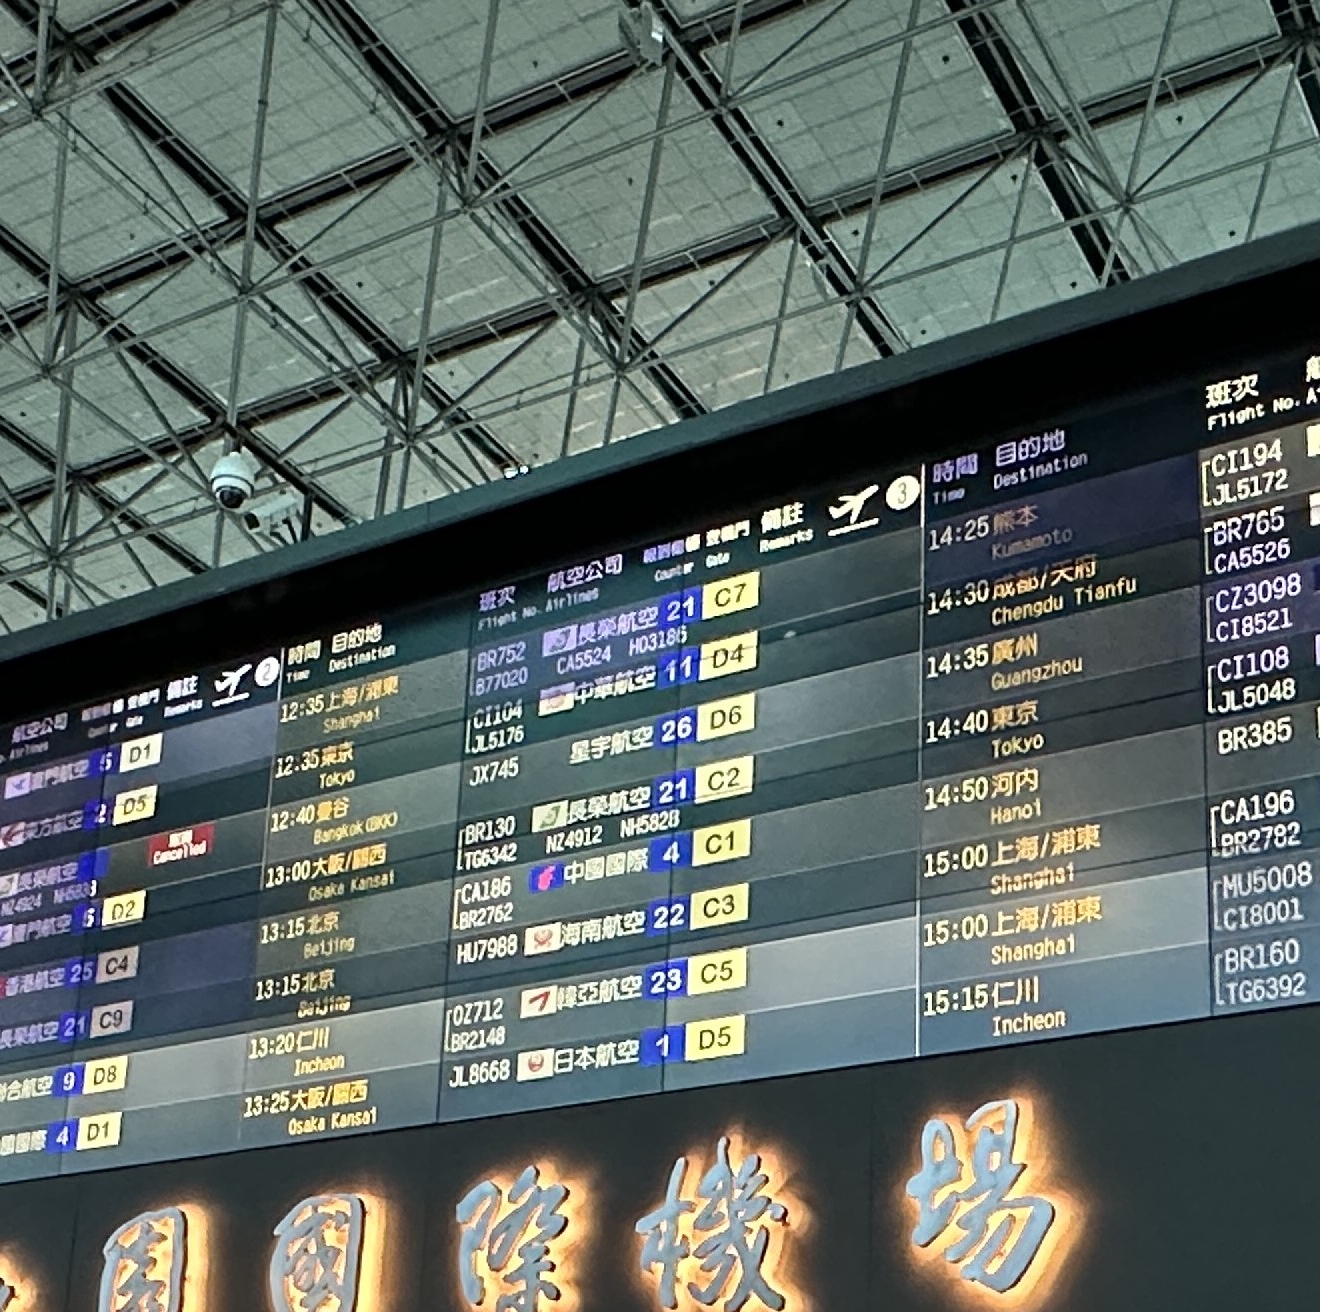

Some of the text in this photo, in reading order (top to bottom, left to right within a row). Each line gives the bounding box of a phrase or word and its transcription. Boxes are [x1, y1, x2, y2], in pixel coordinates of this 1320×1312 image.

[1205, 374, 1258, 407] 班次
[996, 429, 1065, 467] 目的地
[1212, 440, 1283, 477] CI194
[993, 450, 1088, 491] Destination
[1212, 471, 1288, 506] JL5172
[929, 515, 990, 551] 14:25
[991, 526, 1073, 560] Kumamoto
[1213, 507, 1285, 546] BR765
[1213, 538, 1291, 573] CA5526
[667, 583, 748, 621] 21 C7
[928, 579, 989, 616] 14:30
[991, 576, 1137, 626] Chengdu Tianfu
[1215, 573, 1302, 612] CZ3098
[1215, 607, 1293, 643] CI8521
[477, 642, 527, 672] BR752
[664, 644, 744, 681] 11 D4
[926, 644, 989, 679] 14:35
[991, 656, 1083, 691] Guangzhou
[1217, 646, 1290, 683] CI108
[280, 696, 324, 722] 12:35
[1218, 678, 1297, 715] JL5048
[662, 706, 742, 743] 26 D6
[926, 709, 989, 744] 14:40
[1217, 716, 1293, 756] BR385
[992, 733, 1045, 759] Tokyo
[320, 770, 355, 788] Tokyo
[470, 761, 519, 788] JX745
[659, 767, 740, 804] 21 C2
[924, 776, 989, 811] 14:50
[1221, 789, 1295, 827] CA196
[271, 805, 315, 832] 12:40
[990, 798, 1042, 825] Hanoi
[465, 816, 516, 845] BR130
[705, 831, 736, 854] C1
[1221, 820, 1301, 859] BR2782
[923, 845, 988, 878] 15:00
[991, 862, 1075, 895] Shanghai
[461, 876, 511, 904] CA186
[1221, 861, 1314, 900] MU5008
[654, 904, 685, 929] 22
[703, 894, 735, 917] C3
[1221, 897, 1304, 931] CI8001
[261, 917, 305, 944] 13:15
[923, 913, 989, 948] 15:00
[105, 953, 128, 975] C4
[991, 933, 1076, 965] Shanghai
[1224, 939, 1300, 975] BR160
[651, 960, 733, 993] 23 C5
[1225, 970, 1307, 1006] TG6392
[923, 975, 1039, 1017] 15:15 仁川
[992, 1009, 1065, 1037] Incheon
[249, 1027, 330, 1060] 13:20 仁川
[555, 1027, 732, 1074] 日本航空 D5
[294, 1055, 344, 1076] Incheon
[449, 1060, 510, 1088] JL8668
[243, 1091, 290, 1118] 13:25
[289, 1107, 377, 1135] Osaka Kansai
[87, 1121, 110, 1140] D1
